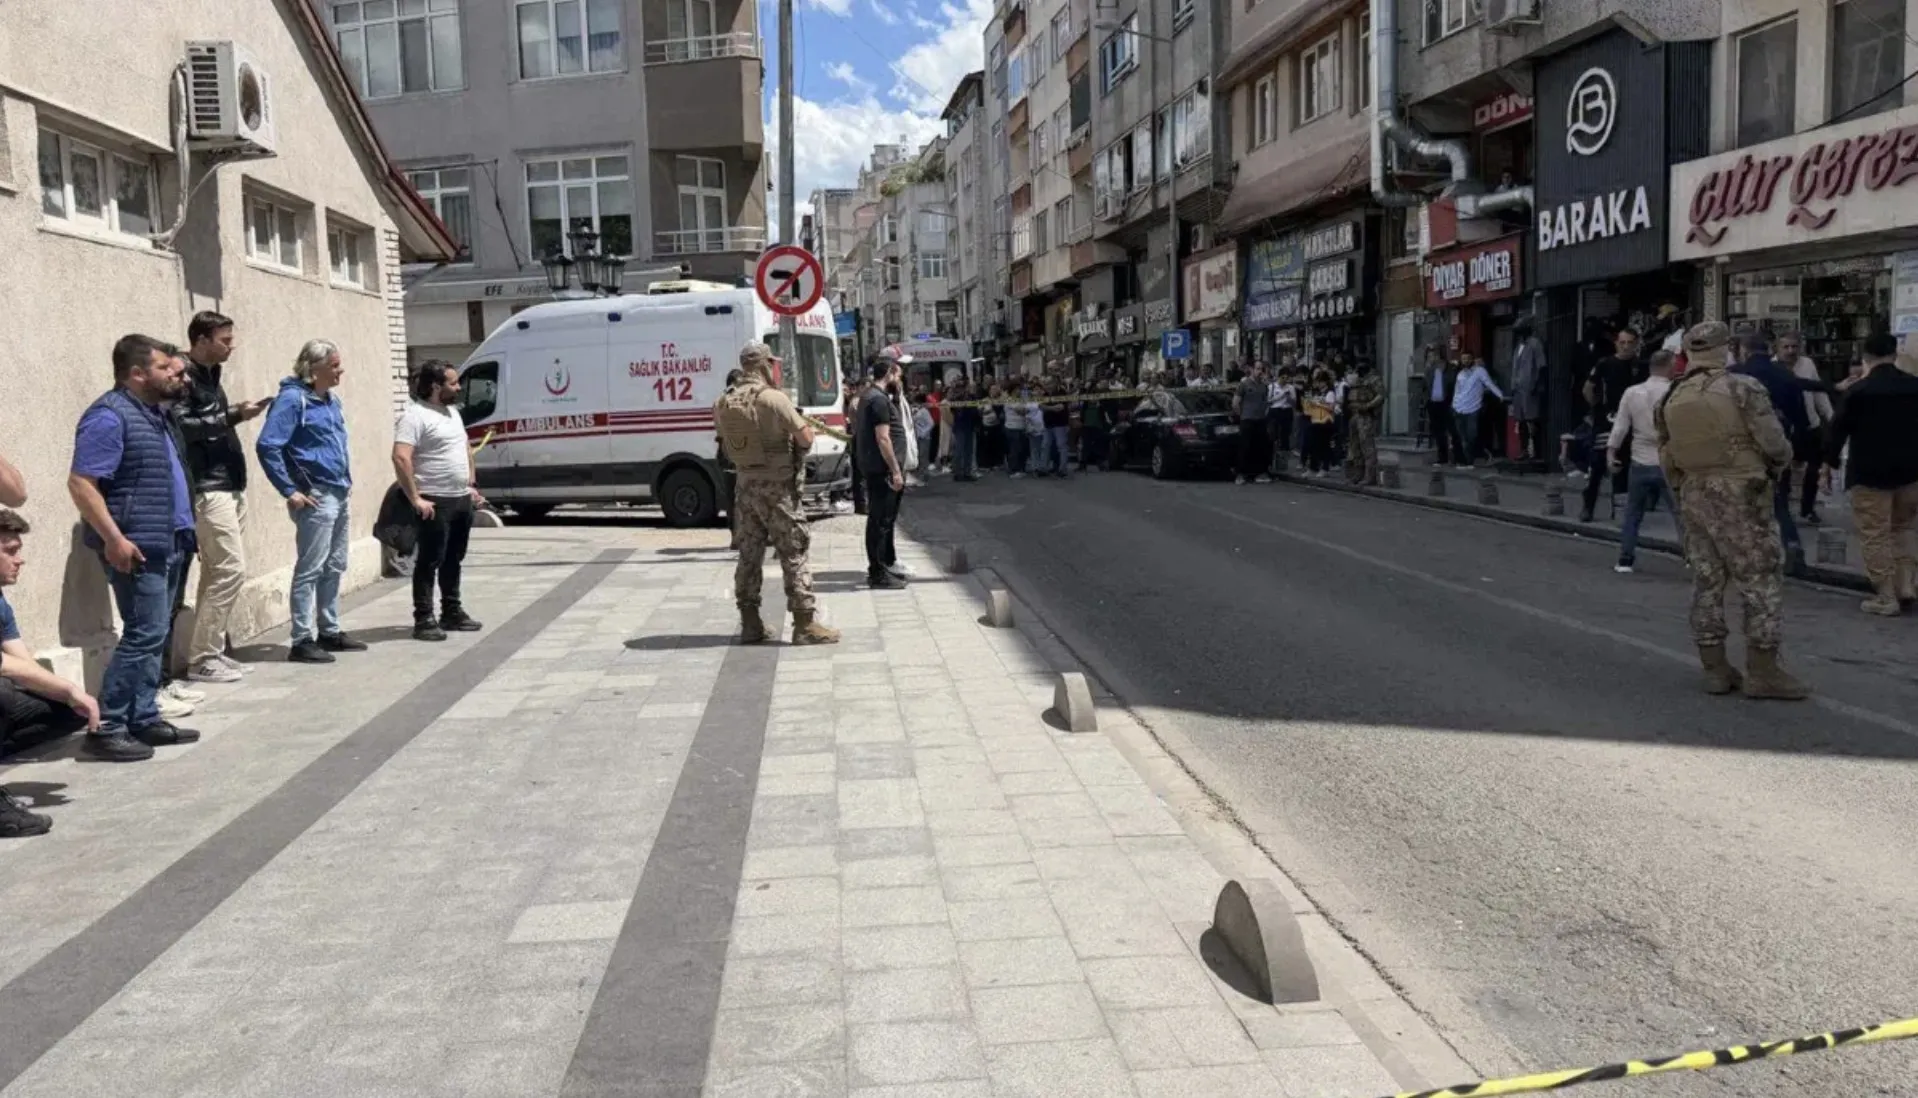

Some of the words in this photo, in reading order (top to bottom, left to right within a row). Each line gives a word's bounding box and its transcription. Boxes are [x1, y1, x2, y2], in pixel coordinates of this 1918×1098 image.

[1538, 185, 1652, 252] BARAKA
[1469, 250, 1511, 285] DÖNER
[772, 311, 827, 329] AULANS
[660, 343, 679, 358] T.C.
[629, 358, 661, 378] SAĞLIK
[661, 354, 712, 376] BAKANLIĞI
[652, 376, 693, 402] 112
[515, 413, 595, 434] AMBULANS
